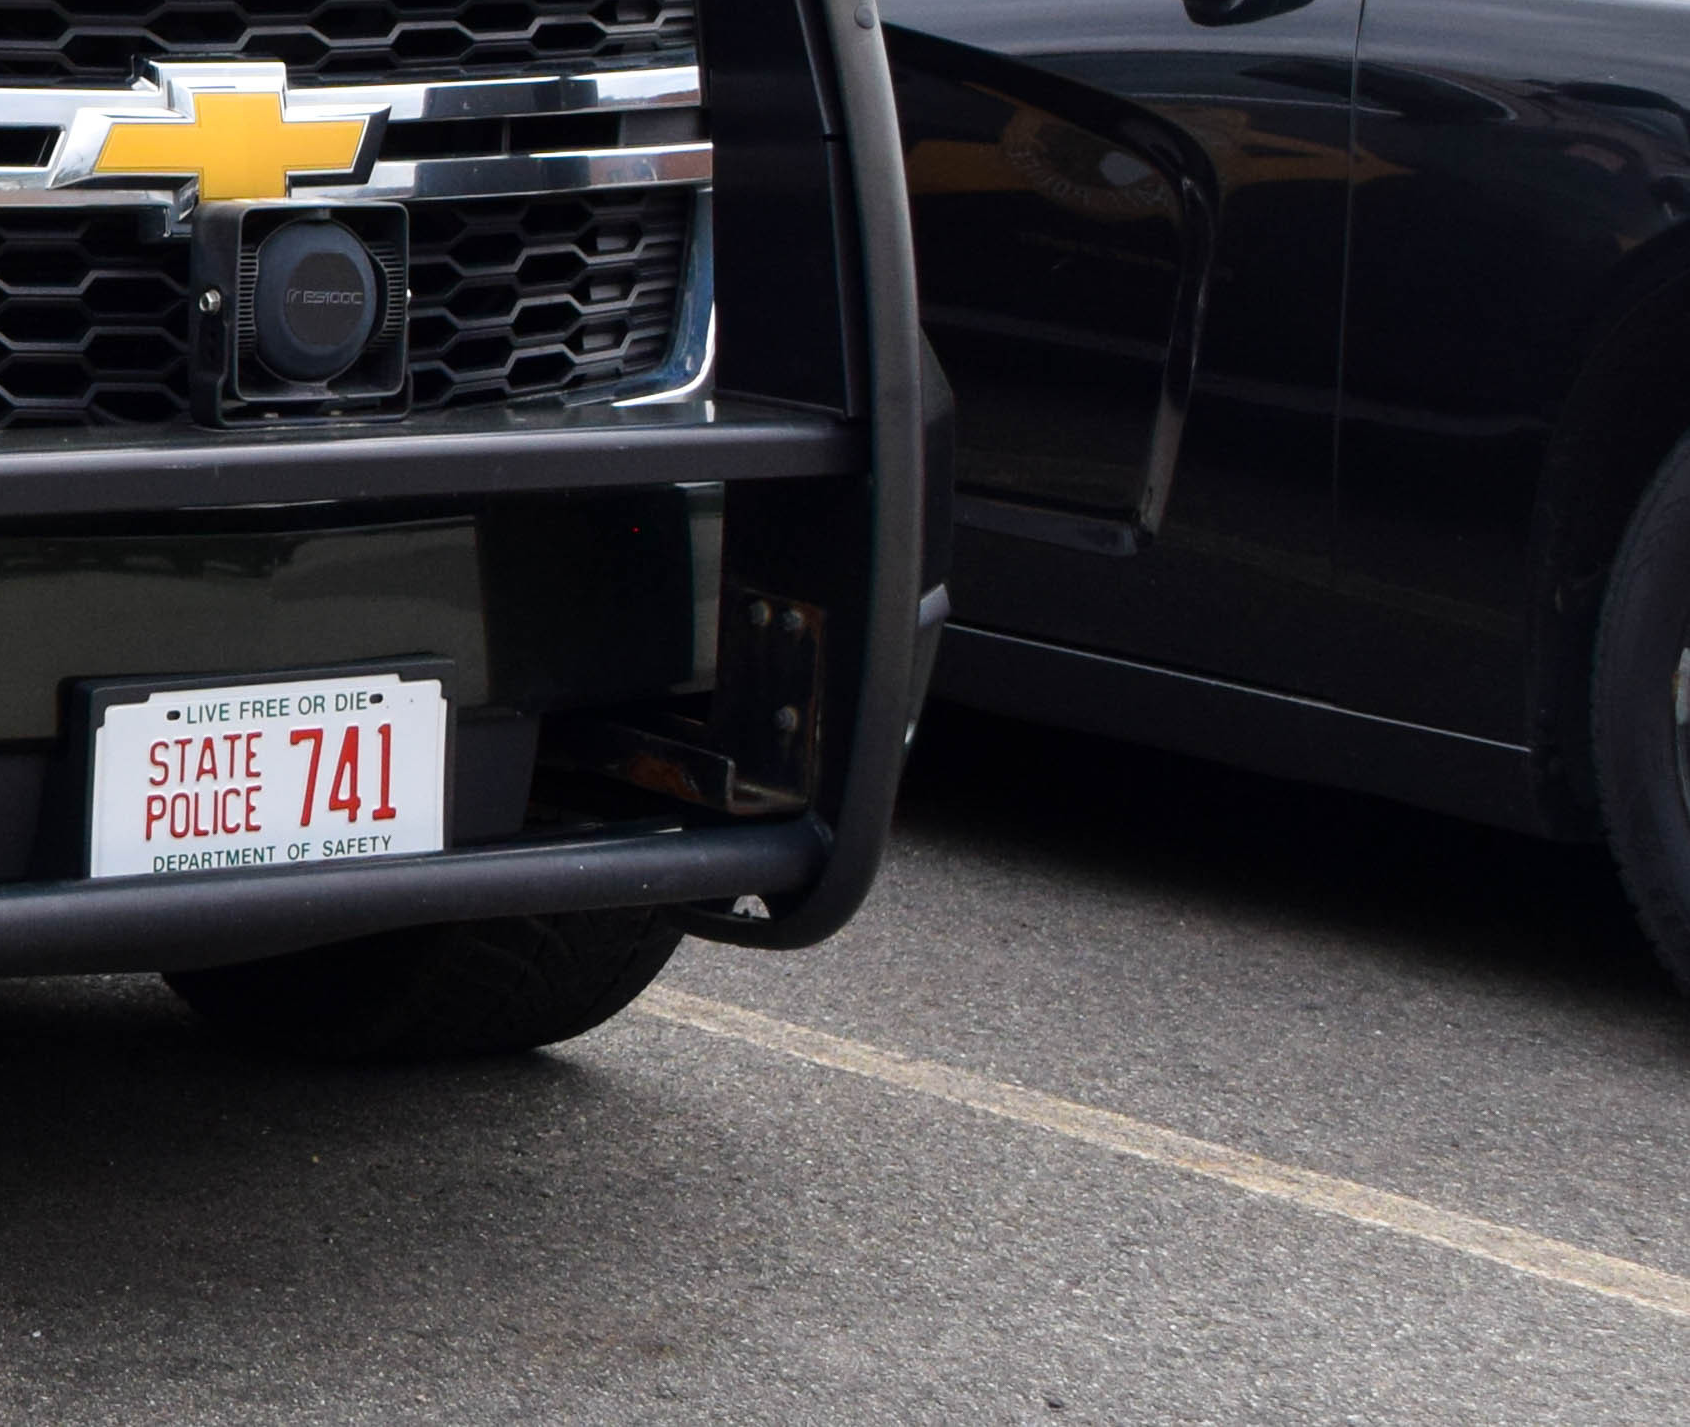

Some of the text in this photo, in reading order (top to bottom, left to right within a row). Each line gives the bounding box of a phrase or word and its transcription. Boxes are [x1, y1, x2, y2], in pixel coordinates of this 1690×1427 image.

[186, 691, 368, 725] LIVE FREE OR DIE
[149, 731, 263, 787] STATE
[290, 723, 397, 827] 741
[145, 785, 263, 841] POLICE
[153, 835, 392, 873] DEPARTMENT OF SAFETY
